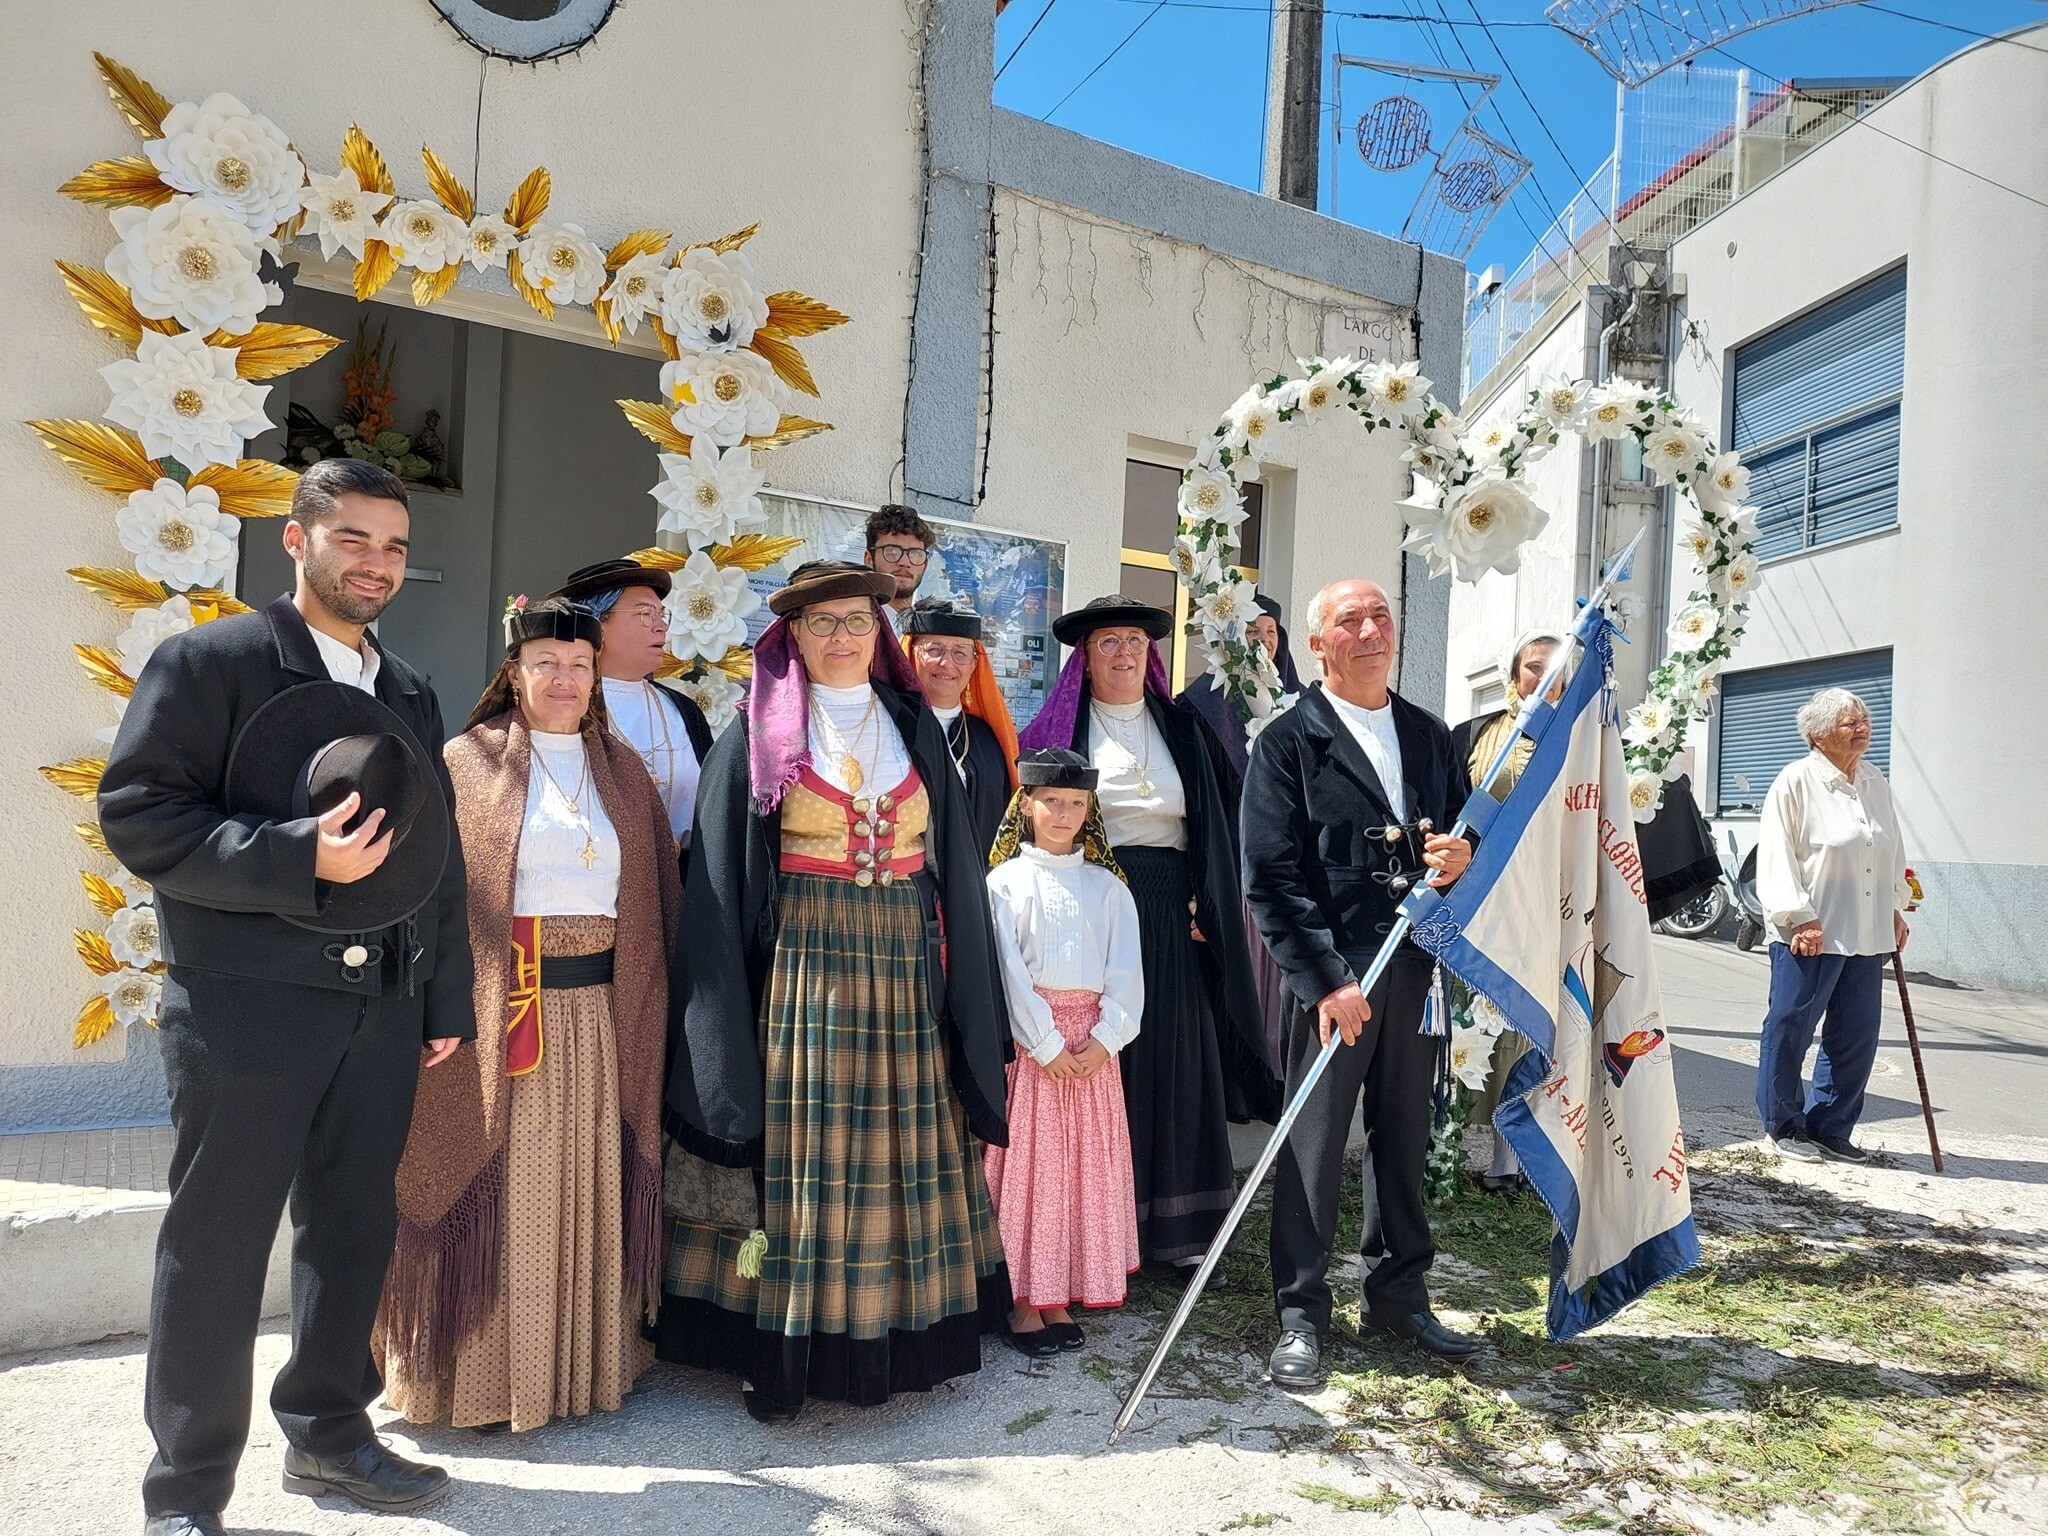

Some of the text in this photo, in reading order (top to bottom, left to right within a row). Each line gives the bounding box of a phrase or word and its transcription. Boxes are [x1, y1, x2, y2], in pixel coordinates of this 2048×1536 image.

[1344, 316, 1393, 341] LARGO
[1358, 345, 1376, 363] DE
[1612, 1133, 1634, 1179] 1978
